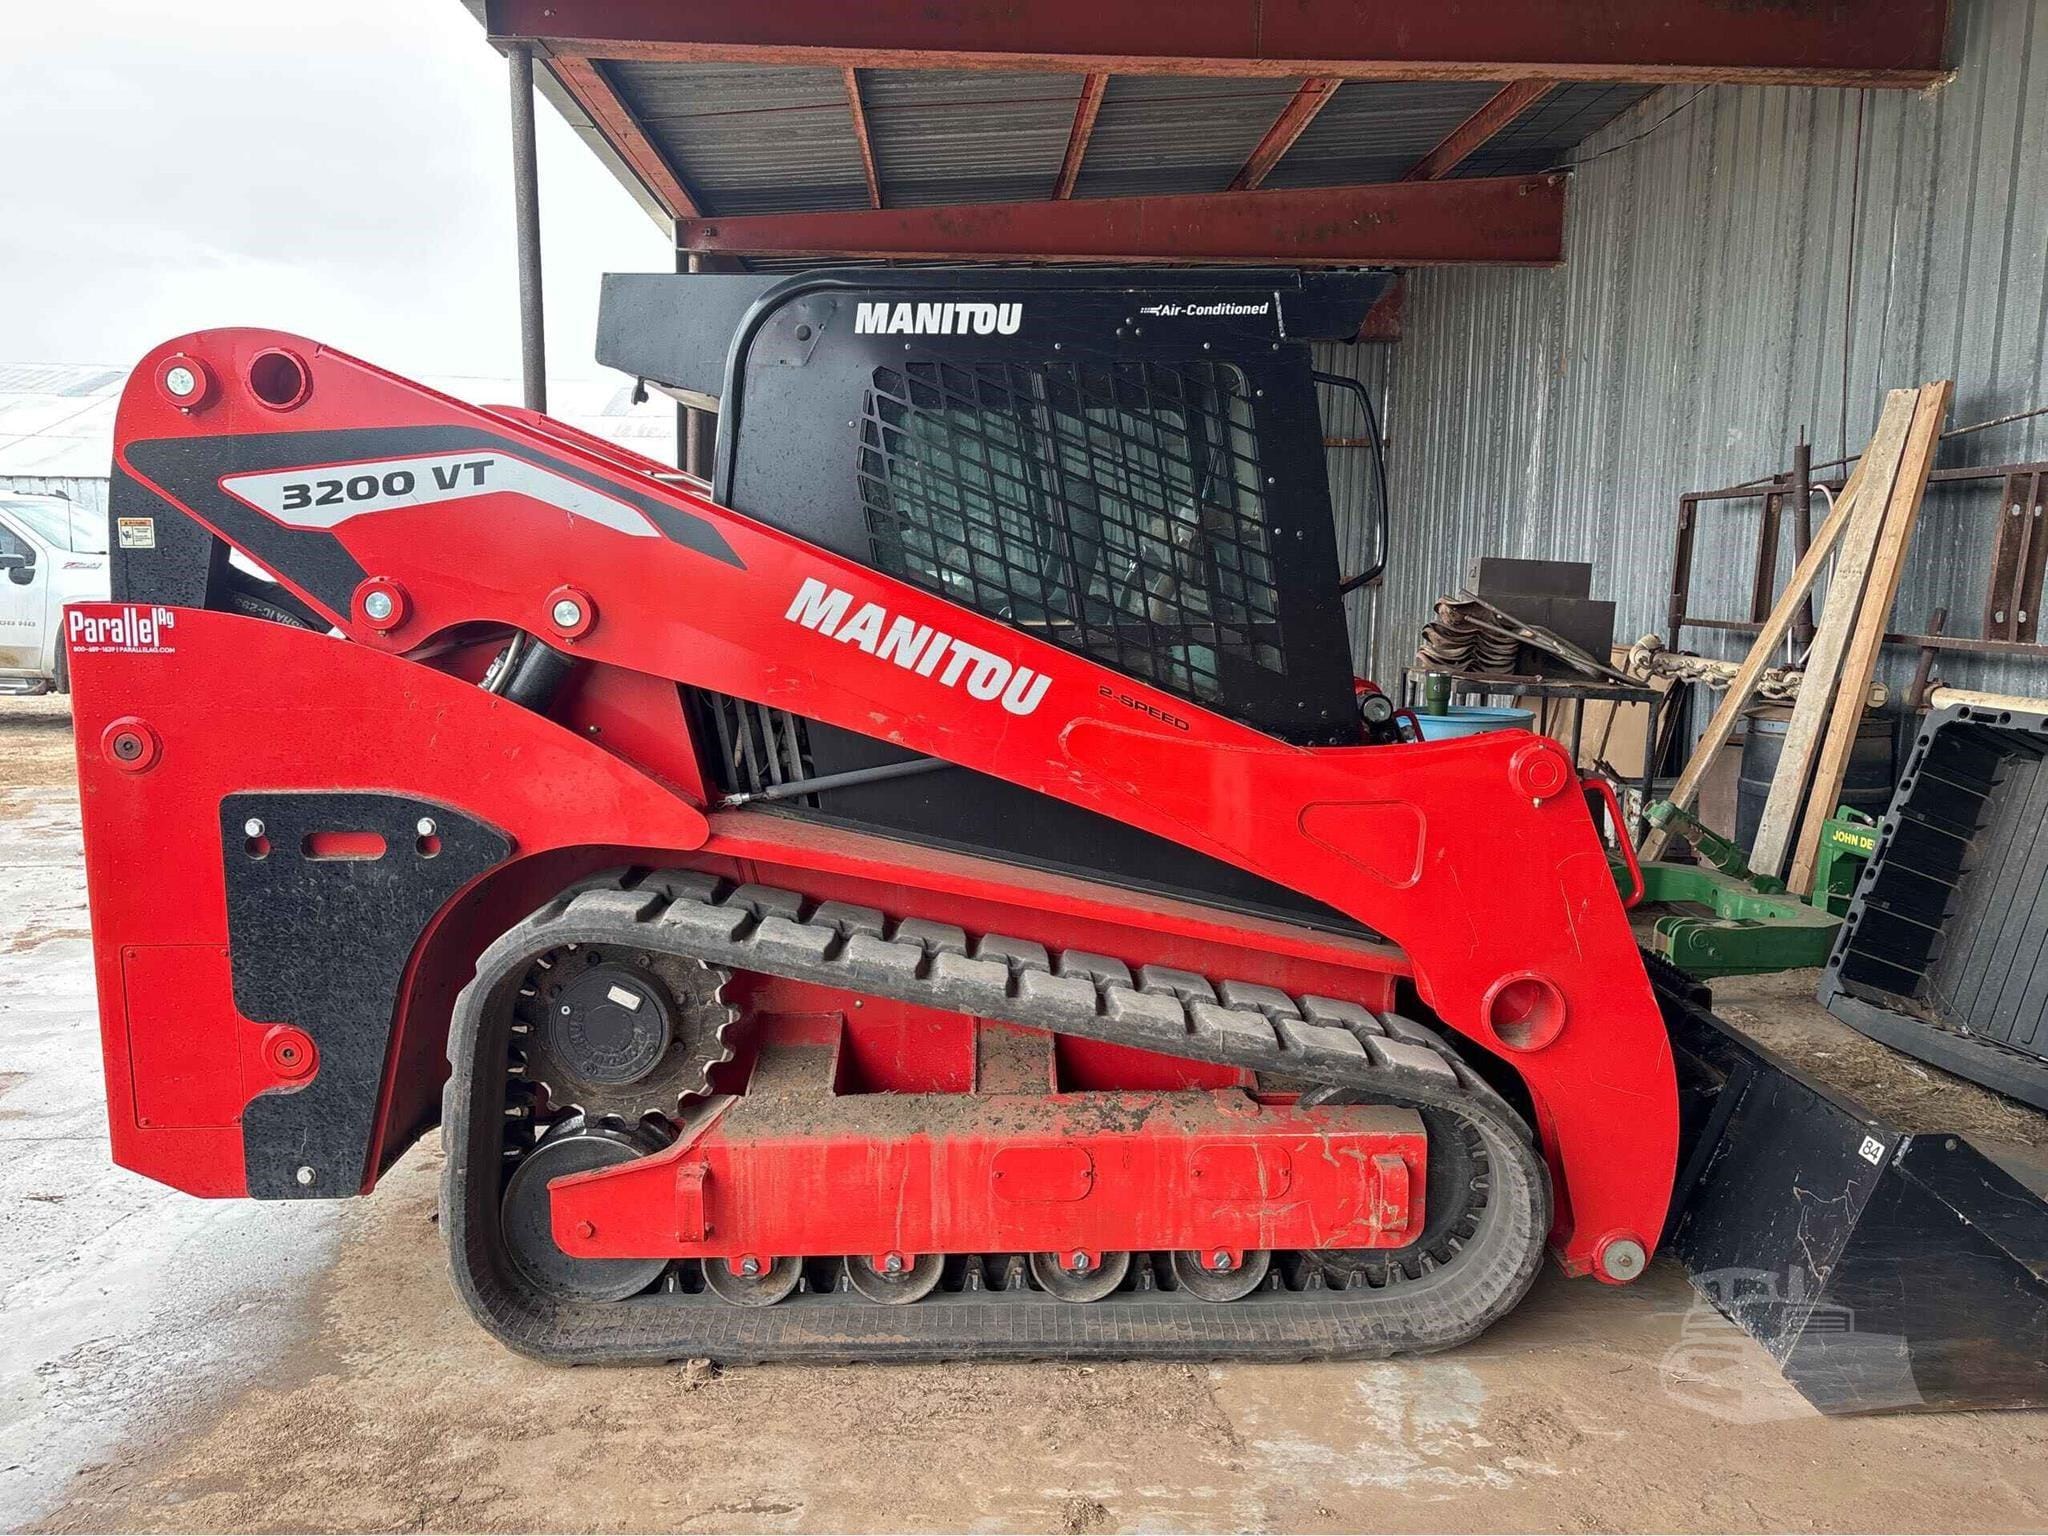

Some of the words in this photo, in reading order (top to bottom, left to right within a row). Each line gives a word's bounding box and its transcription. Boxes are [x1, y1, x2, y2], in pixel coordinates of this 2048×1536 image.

[854, 303, 1023, 335] MANITOU
[1161, 302, 1269, 316] Air-Conditioned
[283, 470, 415, 510] 3200
[432, 459, 495, 491] VT
[784, 577, 1053, 716] MANITOU
[1099, 685, 1190, 731] 2-SPEED
[1832, 830, 1859, 847] JOHN
[1860, 837, 1876, 850] DE
[1862, 1140, 1881, 1161] 84
